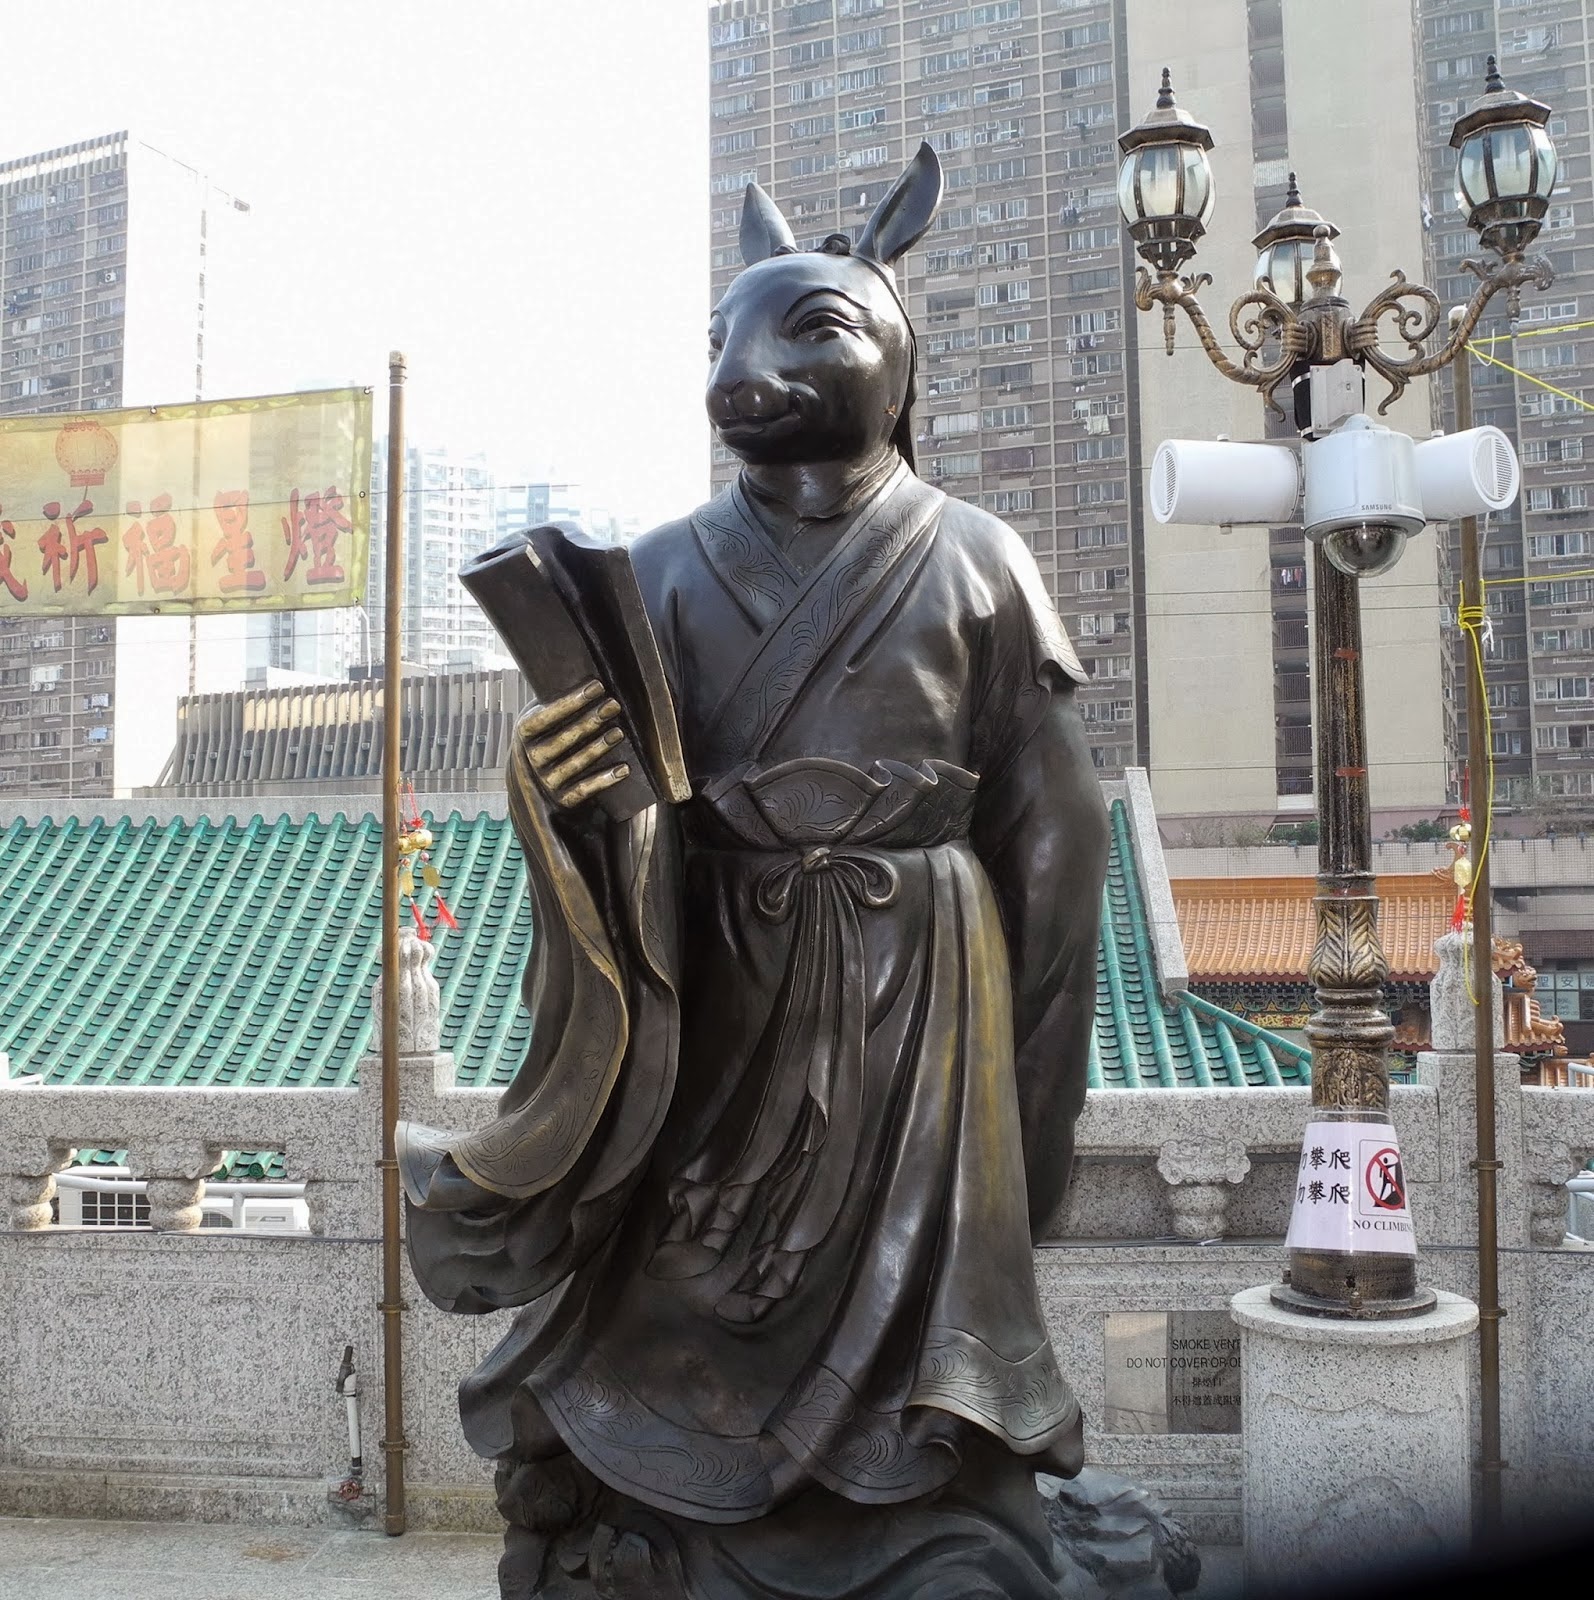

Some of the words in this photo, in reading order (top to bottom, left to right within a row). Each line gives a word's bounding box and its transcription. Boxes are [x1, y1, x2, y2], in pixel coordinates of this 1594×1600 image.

[1353, 1220, 1371, 1230] NO
[1172, 1339, 1211, 1350] SMOKE
[1126, 1358, 1143, 1368] DO
[1145, 1357, 1167, 1368] NOT
[1170, 1357, 1208, 1368] COVER
[1211, 1357, 1227, 1368] OR
